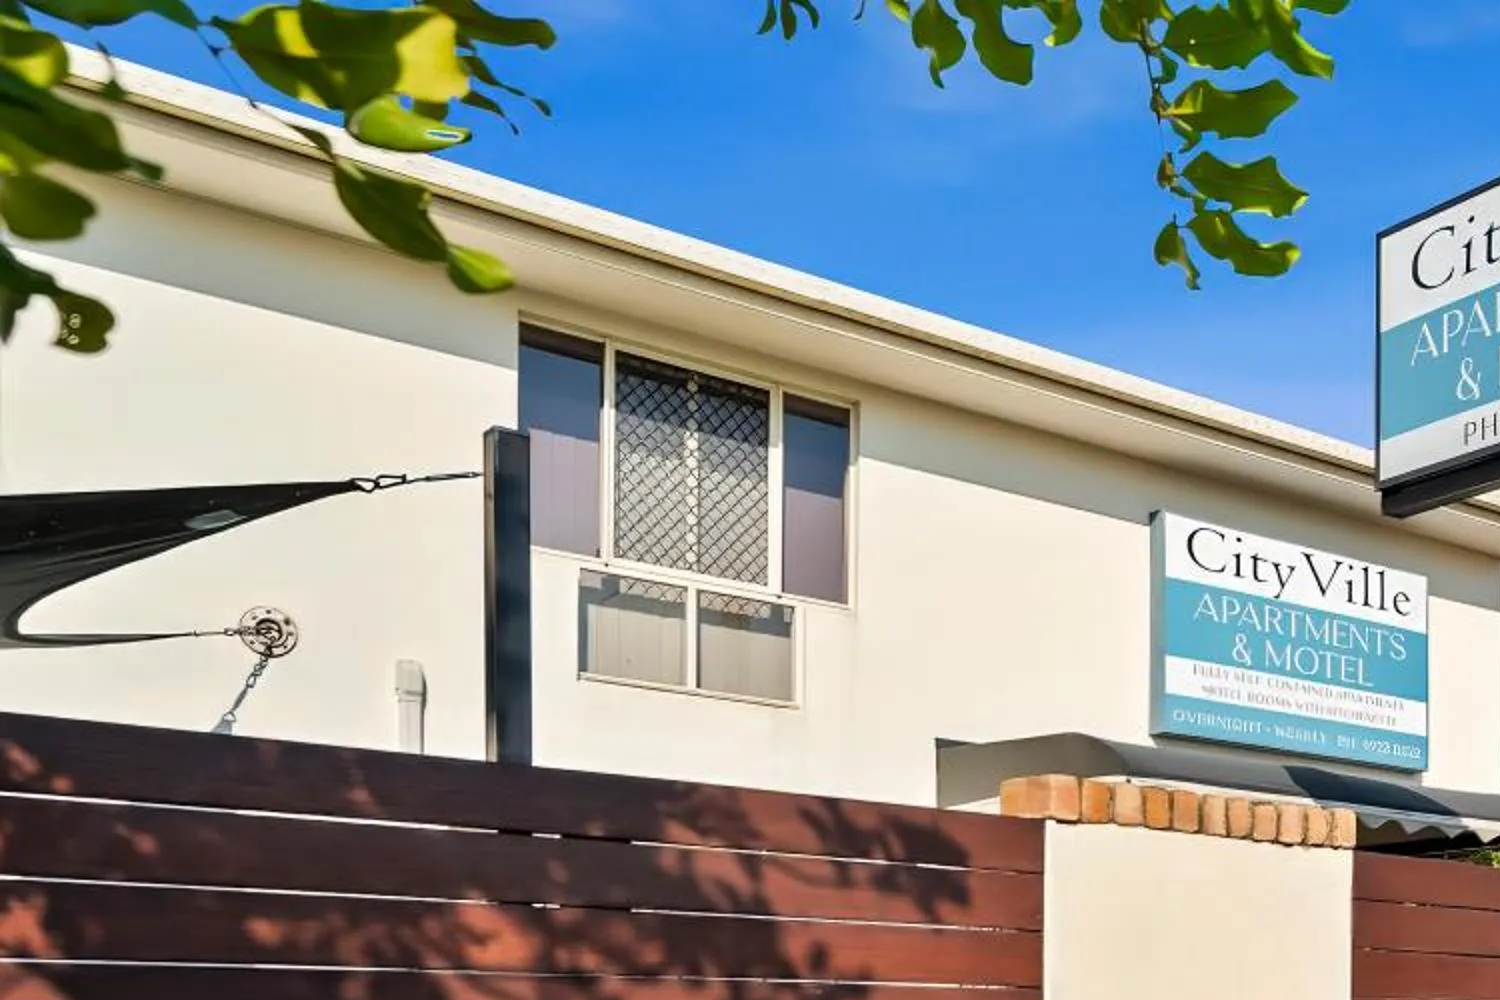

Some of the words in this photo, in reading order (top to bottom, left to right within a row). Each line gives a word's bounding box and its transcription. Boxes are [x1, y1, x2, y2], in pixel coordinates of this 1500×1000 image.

[1455, 356, 1482, 401] &
[1187, 527, 1296, 599] City
[1300, 551, 1412, 617] Ville
[1193, 592, 1407, 661] APARTMENTS
[1231, 632, 1252, 667] &
[1265, 639, 1375, 688] MOTEL
